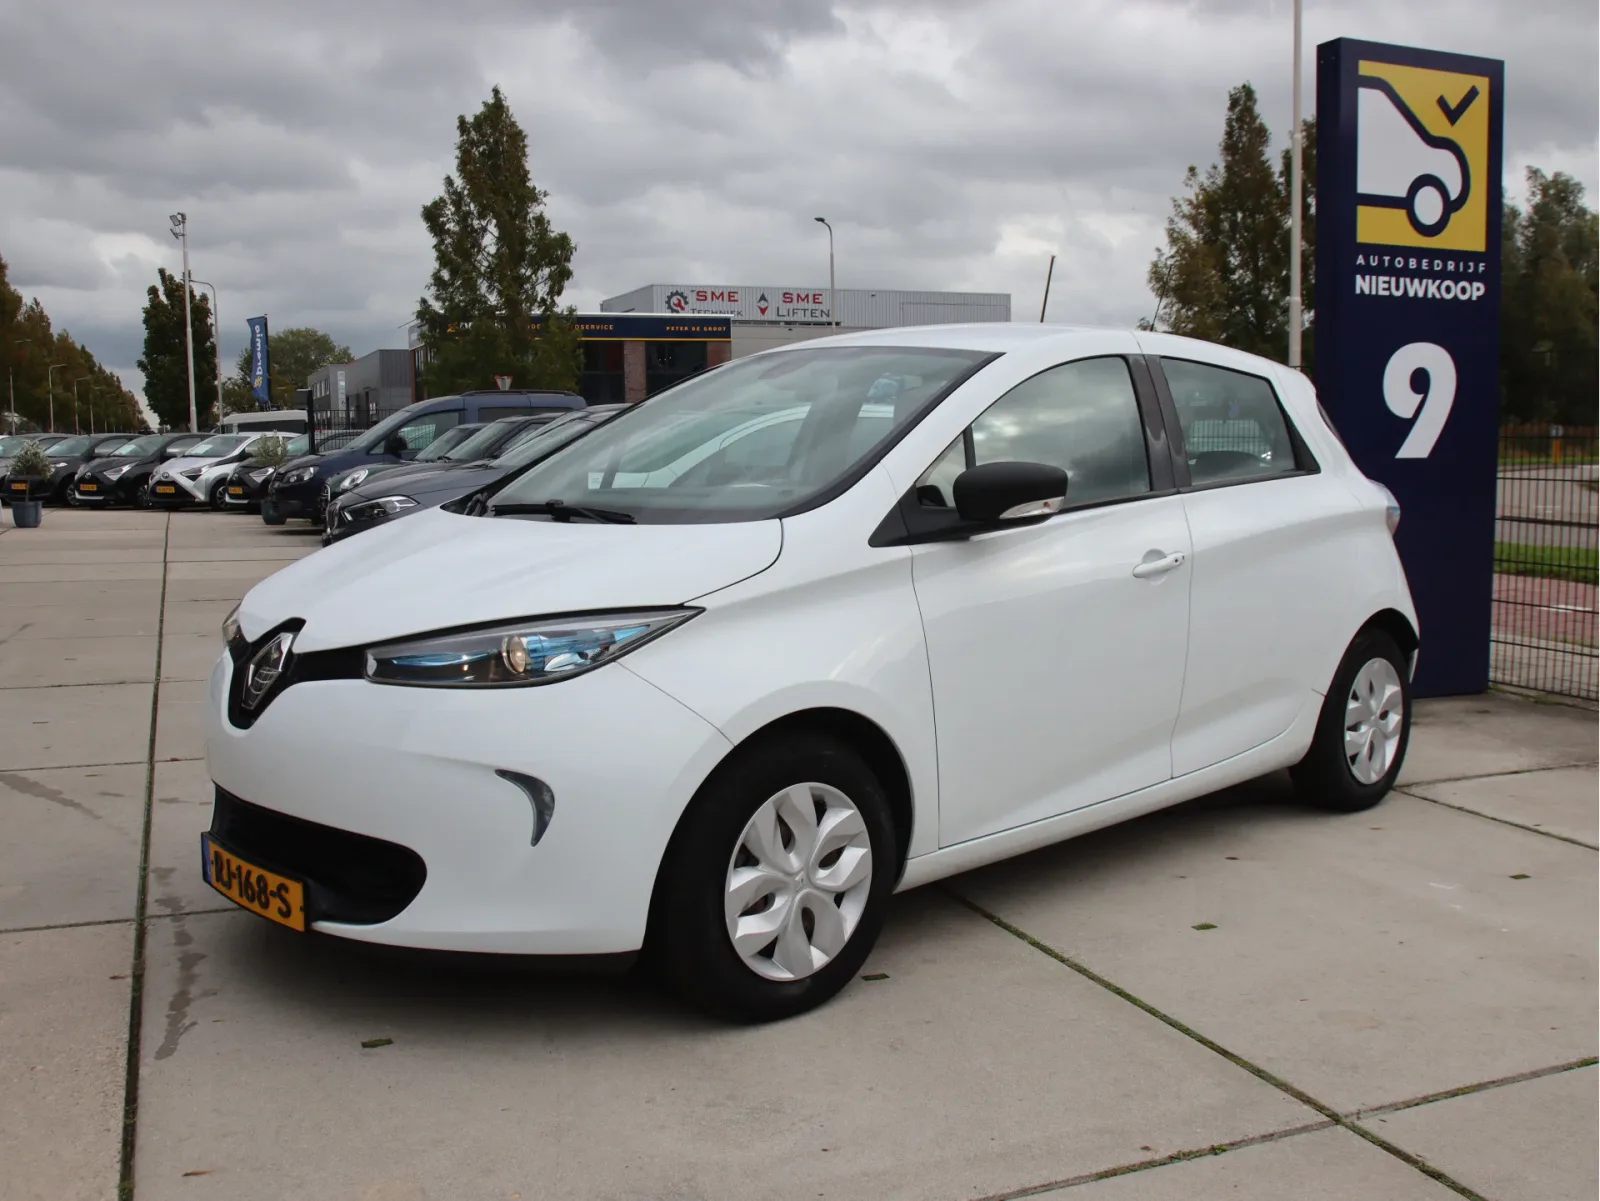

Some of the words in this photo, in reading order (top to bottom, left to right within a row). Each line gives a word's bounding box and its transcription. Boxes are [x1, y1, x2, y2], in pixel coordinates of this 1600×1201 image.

[1356, 254, 1486, 274] AUTOBEDRIJF
[696, 290, 739, 302] SME
[1355, 274, 1485, 301] NIEUWKOOP
[782, 291, 823, 305] SME
[776, 306, 831, 318] LIFTEN
[254, 324, 263, 375] premio
[1382, 341, 1458, 459] 9
